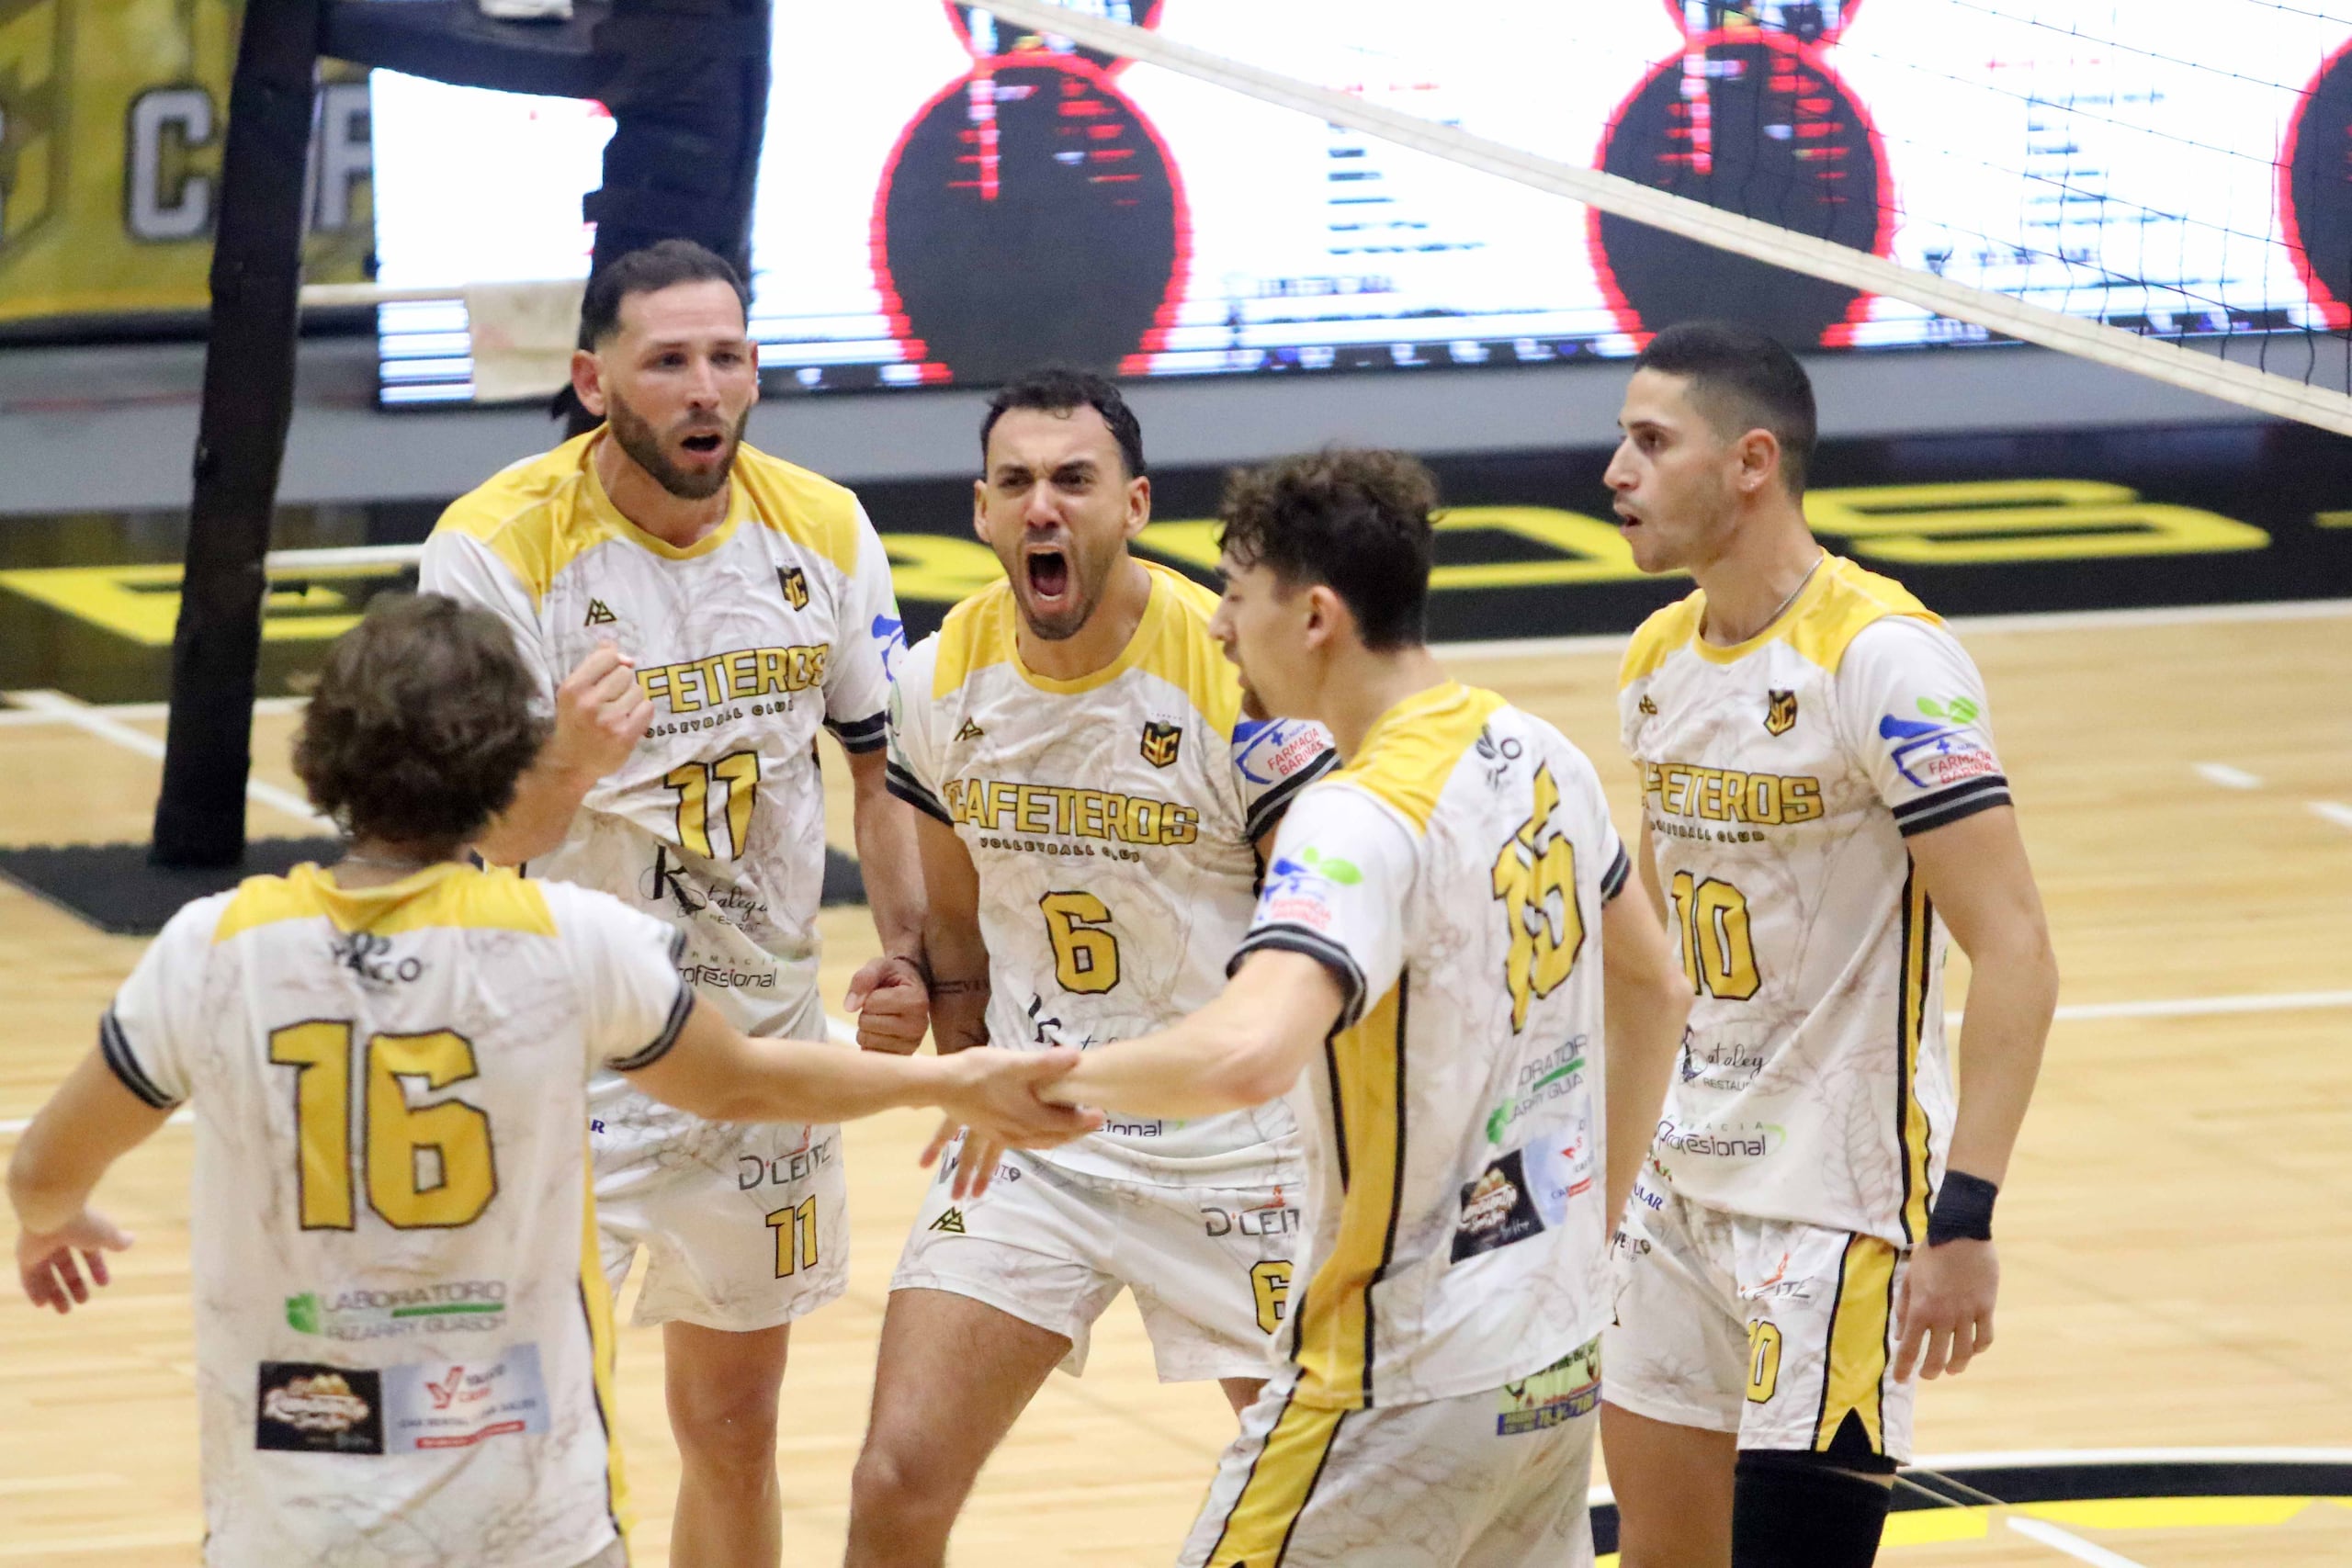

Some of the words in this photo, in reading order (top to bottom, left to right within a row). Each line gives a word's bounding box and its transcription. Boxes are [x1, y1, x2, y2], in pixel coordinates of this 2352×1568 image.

[1267, 728, 1320, 771] FARMACIA
[662, 750, 761, 861] 11
[1039, 890, 1120, 995] 6
[1670, 869, 1762, 1001] 10
[268, 1018, 500, 1232] 16
[765, 1194, 819, 1280] 11
